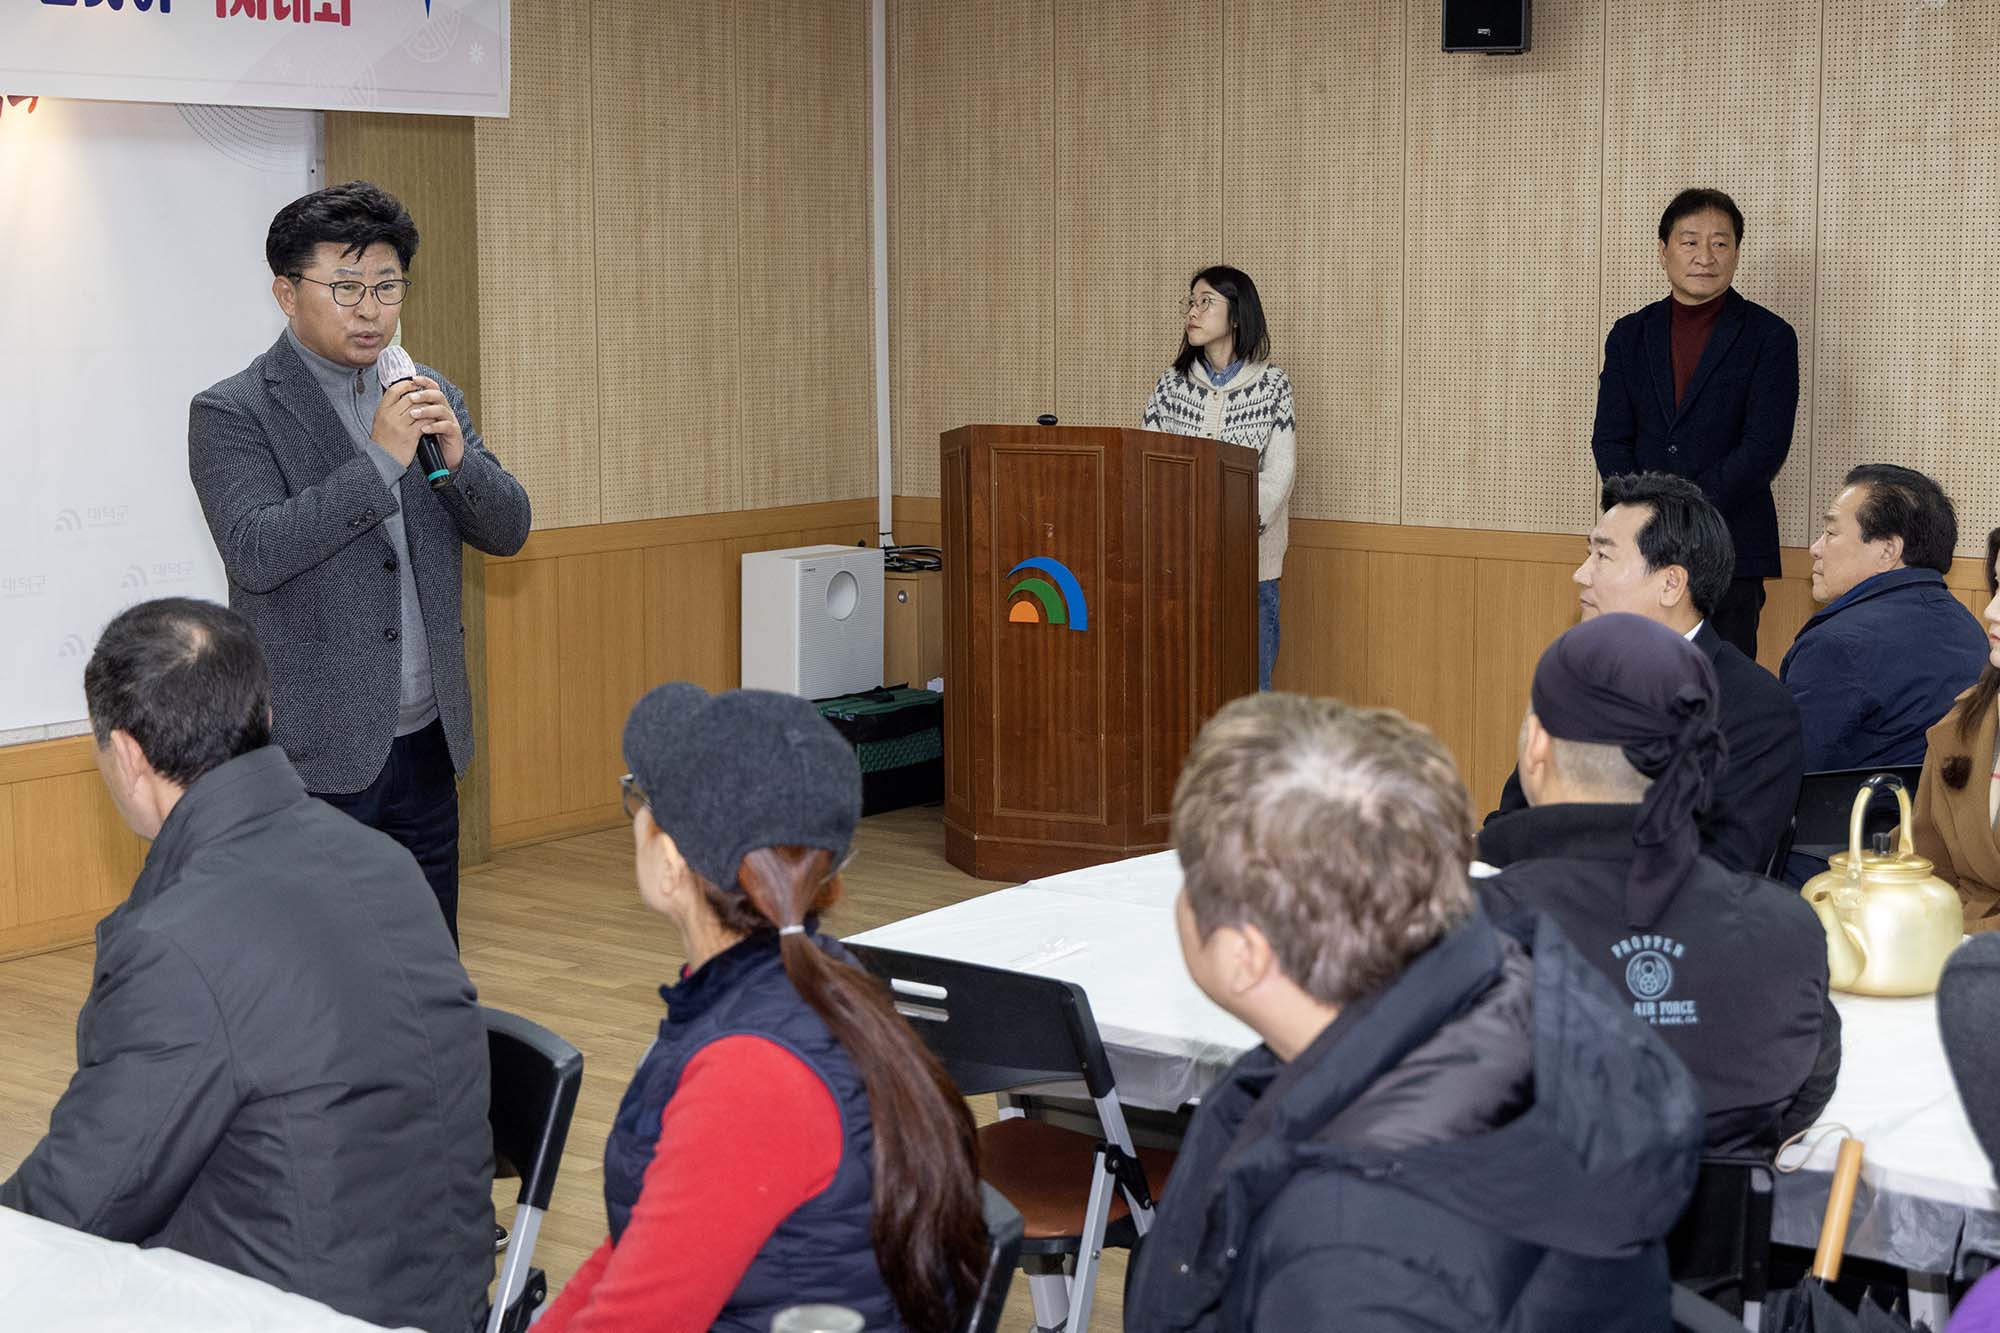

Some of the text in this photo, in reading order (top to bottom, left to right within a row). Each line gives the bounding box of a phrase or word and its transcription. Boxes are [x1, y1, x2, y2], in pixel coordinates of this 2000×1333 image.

[1611, 935, 1685, 958] PROPPER
[1633, 1000, 1696, 1016] AIR FORCE
